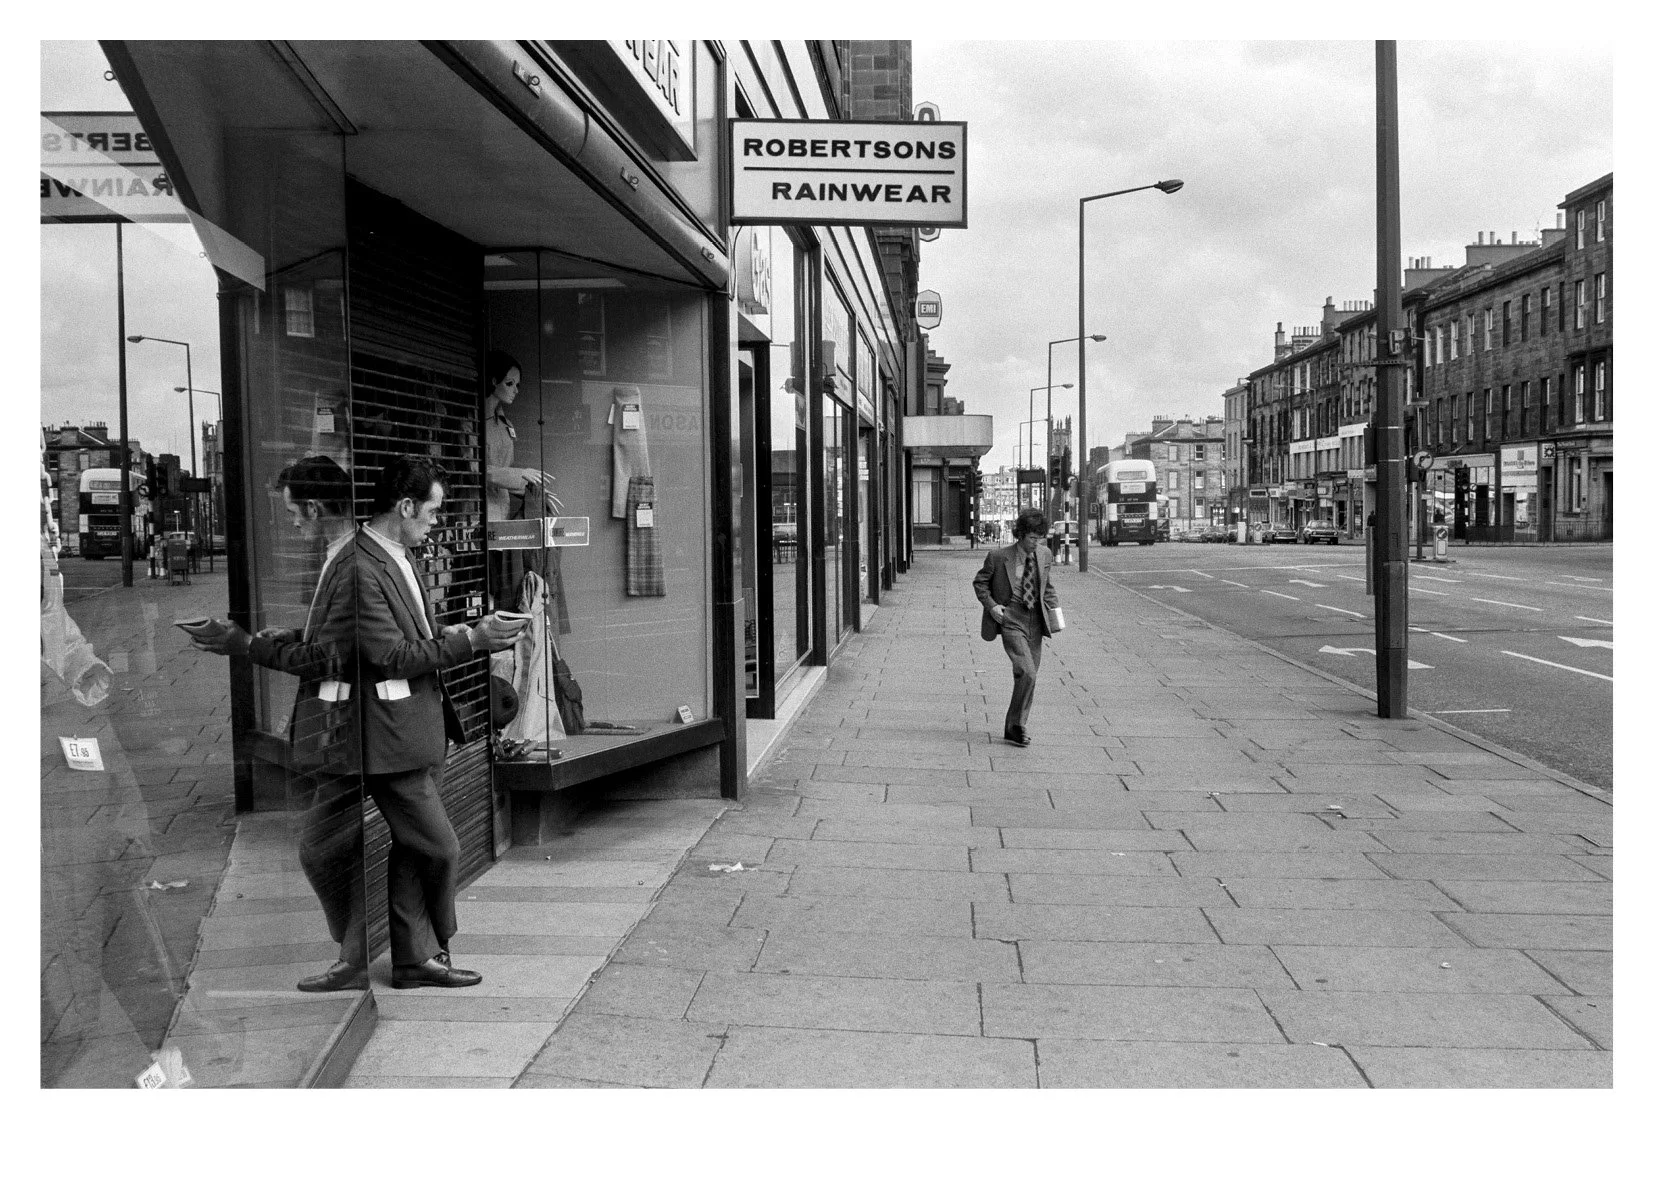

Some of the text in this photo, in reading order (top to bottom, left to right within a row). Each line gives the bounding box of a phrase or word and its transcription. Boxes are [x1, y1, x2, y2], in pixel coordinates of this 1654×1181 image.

[743, 138, 956, 160] ROBERTSONS
[772, 181, 952, 203] RAINWEAR
[921, 303, 937, 314] EMI
